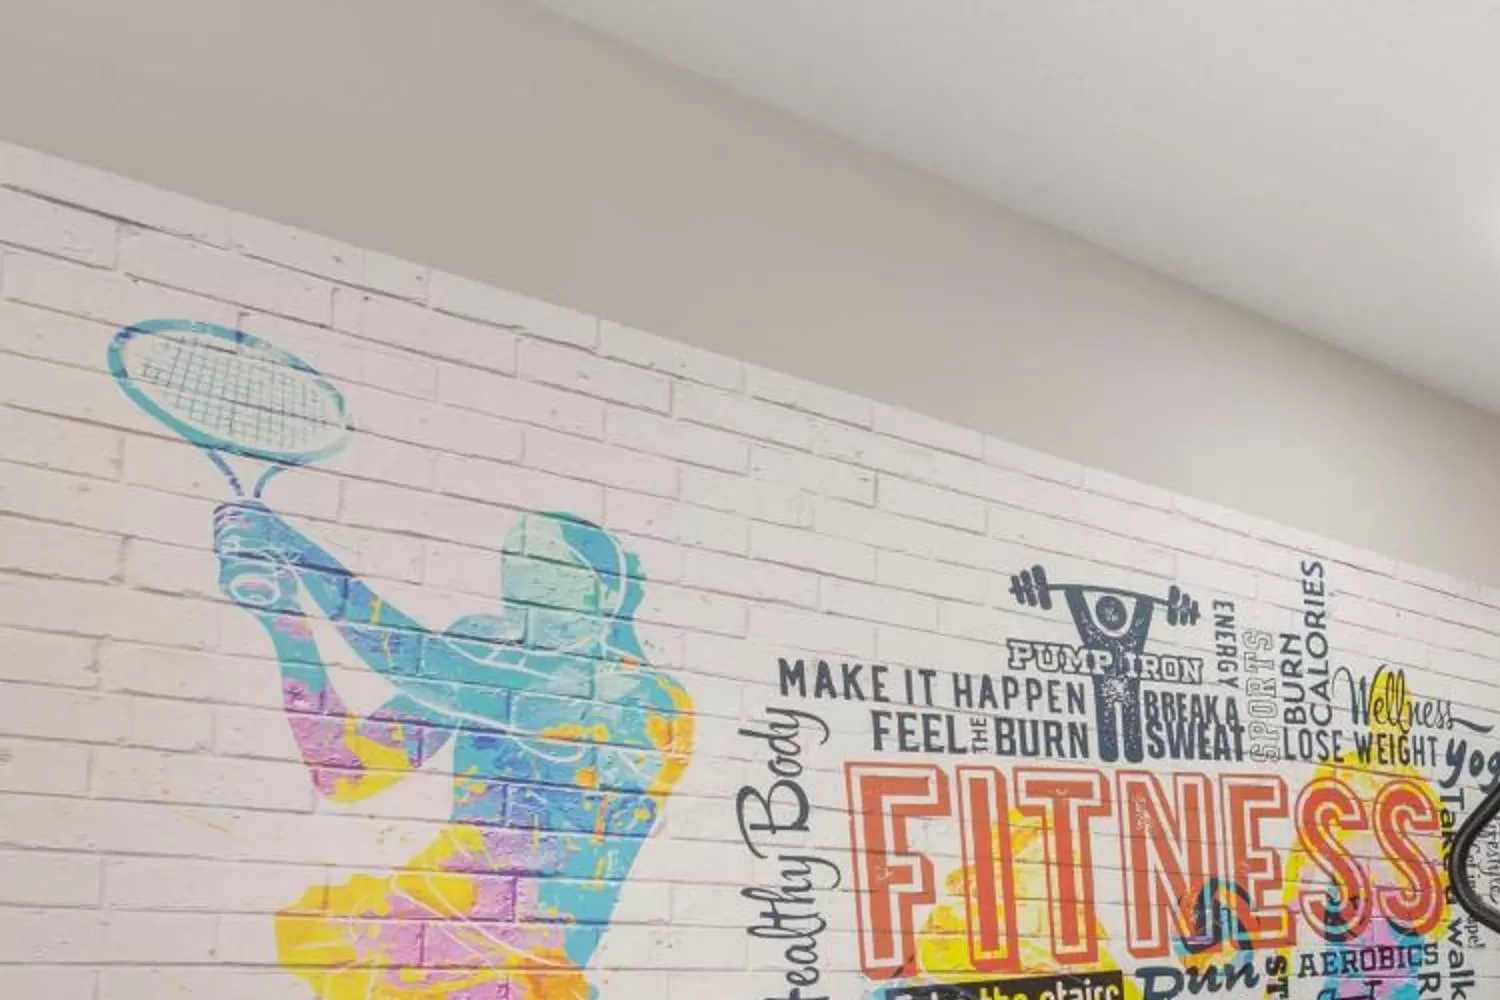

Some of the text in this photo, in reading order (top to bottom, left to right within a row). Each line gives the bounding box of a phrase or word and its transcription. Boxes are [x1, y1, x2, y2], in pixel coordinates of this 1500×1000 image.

[1006, 638, 1204, 684] PUMP IRON
[1213, 600, 1239, 688] ENERGY
[1302, 560, 1332, 726] CALORIES
[778, 658, 1087, 715] MAKE IT HAPPEN
[1143, 690, 1242, 730] BREAK A
[1243, 629, 1281, 763] SPORTS
[1280, 634, 1307, 724] BURN
[1332, 664, 1494, 734] Wellness
[871, 709, 1090, 759] FEEL THE BURN
[1146, 721, 1245, 762] SWEAT
[1284, 727, 1439, 767] LOSE WEIGHT
[737, 707, 829, 859] Body
[843, 762, 1448, 981] FITNESS
[1297, 943, 1439, 978] AEROBICS
[1448, 917, 1475, 1000] walk
